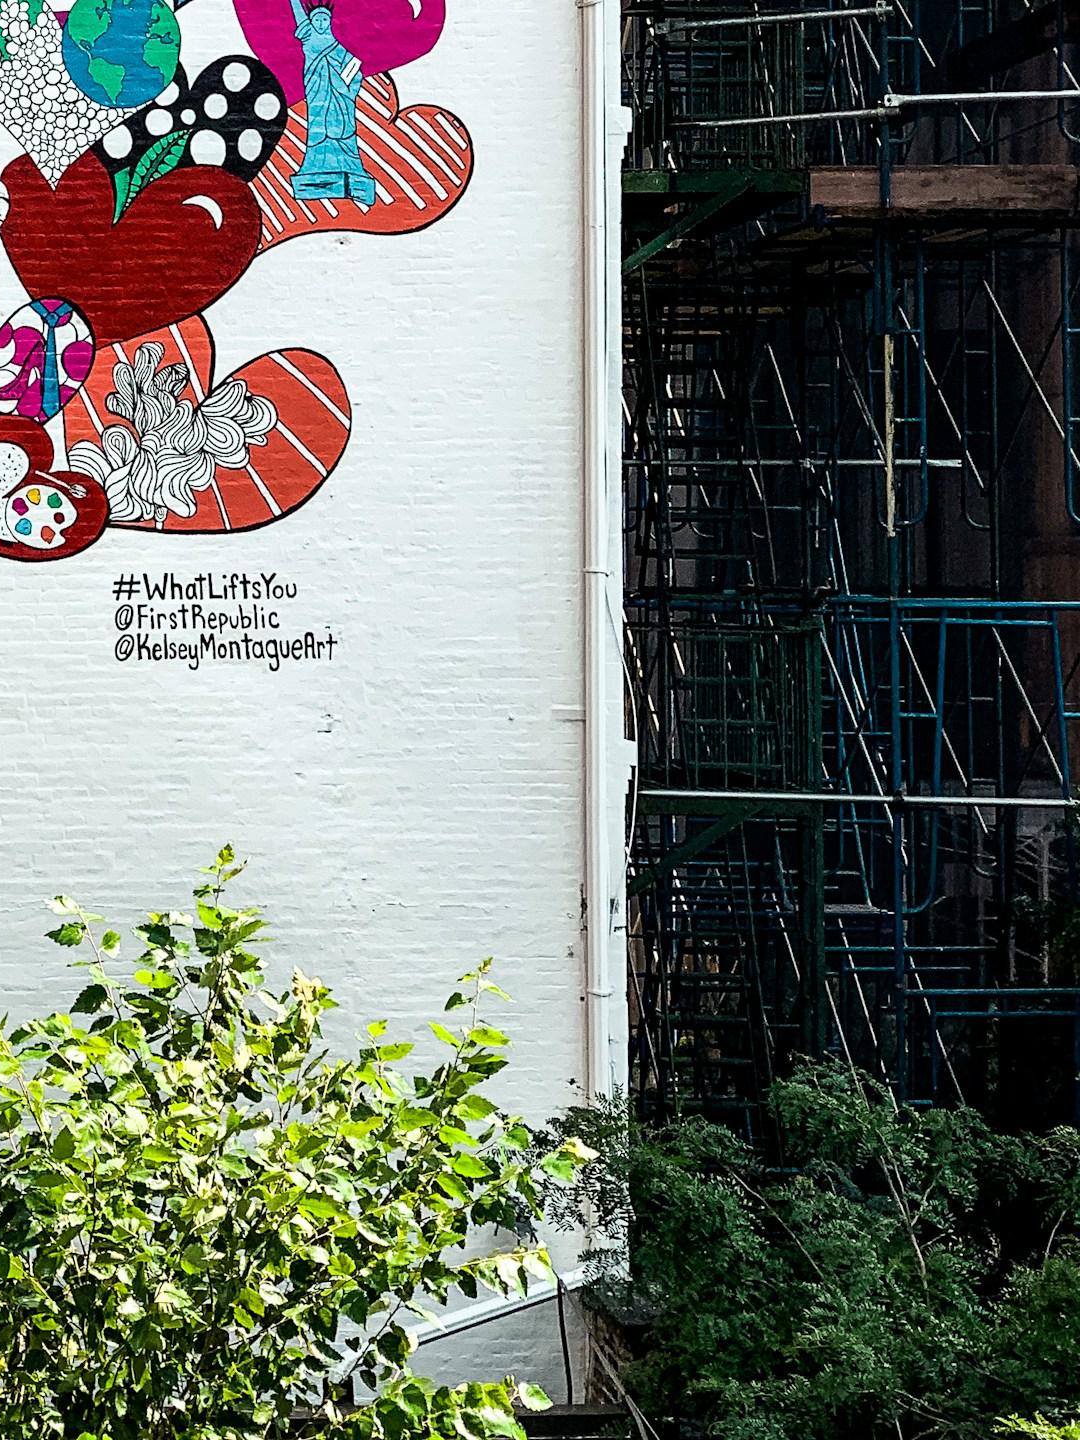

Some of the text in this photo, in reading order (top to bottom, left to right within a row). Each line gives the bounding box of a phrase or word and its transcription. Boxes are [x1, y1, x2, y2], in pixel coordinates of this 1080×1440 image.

[111, 572, 298, 602] #WhatLiftsYou
[114, 603, 281, 635] @FirstRepublic
[114, 631, 339, 672] @KelseyMontagueArt
